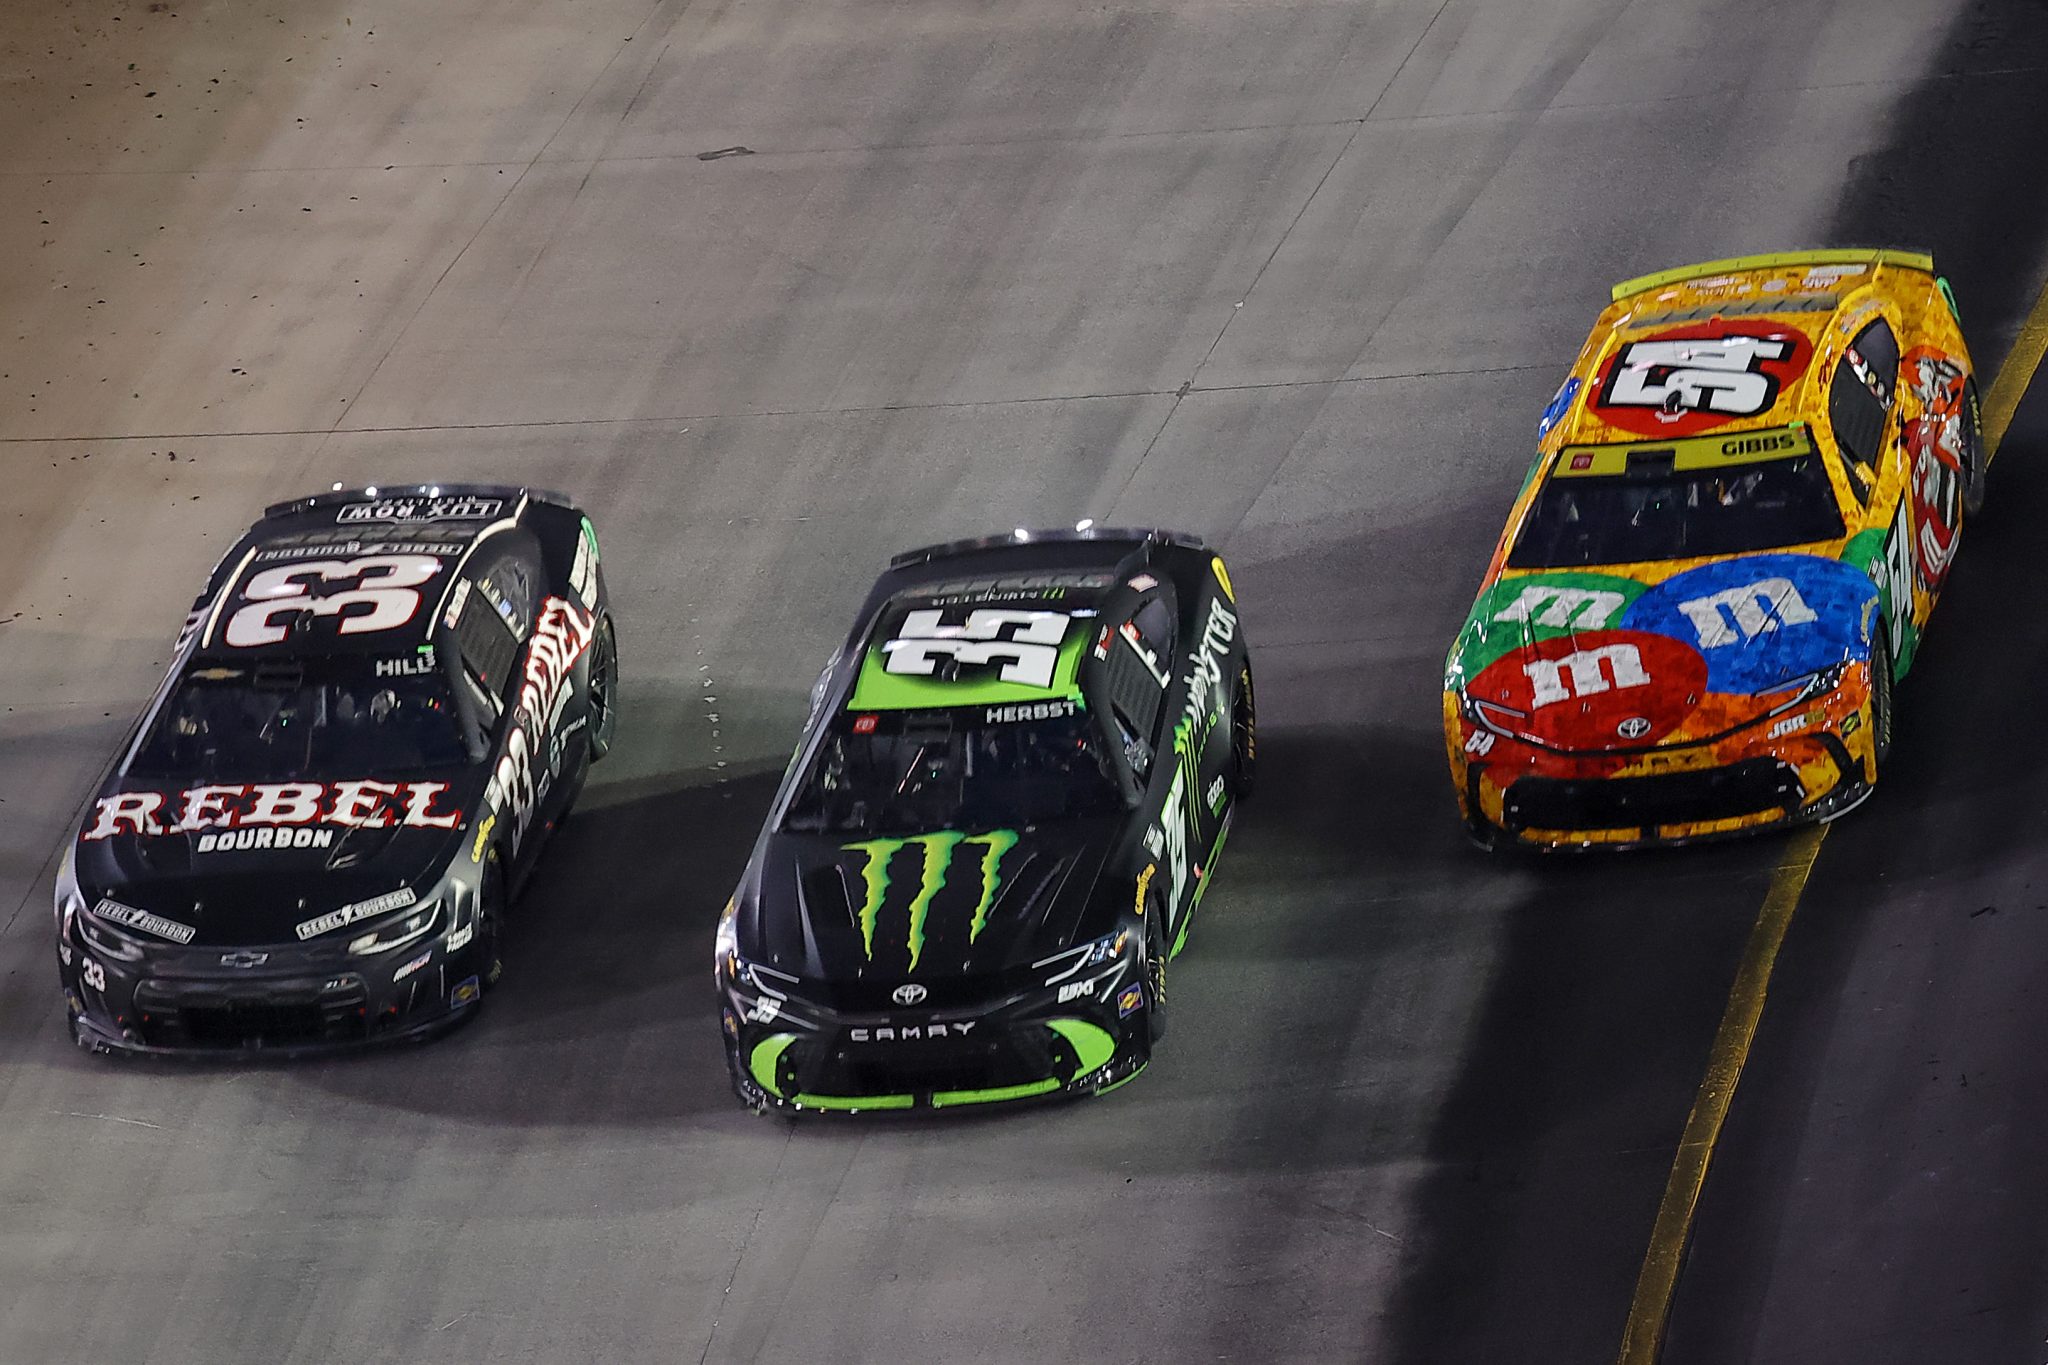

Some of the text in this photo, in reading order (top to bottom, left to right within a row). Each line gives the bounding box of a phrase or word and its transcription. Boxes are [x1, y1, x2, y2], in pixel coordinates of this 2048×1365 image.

[1608, 336, 1785, 414] 54
[1721, 434, 1795, 457] GIBBS
[226, 555, 443, 648] 33
[1493, 585, 1626, 631] m
[1677, 577, 1819, 649] m
[376, 657, 433, 677] HILL
[882, 609, 1071, 688] 35
[1183, 596, 1238, 735] MONSTER
[522, 594, 596, 756] REBEL
[1523, 643, 1651, 710] m
[986, 701, 1078, 724] HERBST
[1465, 730, 1495, 756] 54
[83, 780, 462, 841] REBEL
[497, 728, 534, 859] 33
[198, 827, 334, 853] BOURBON
[99, 901, 191, 941] REBEL BOURBON
[82, 957, 105, 992] 33
[746, 995, 782, 1025] 35
[851, 1021, 976, 1041] CAMRY
